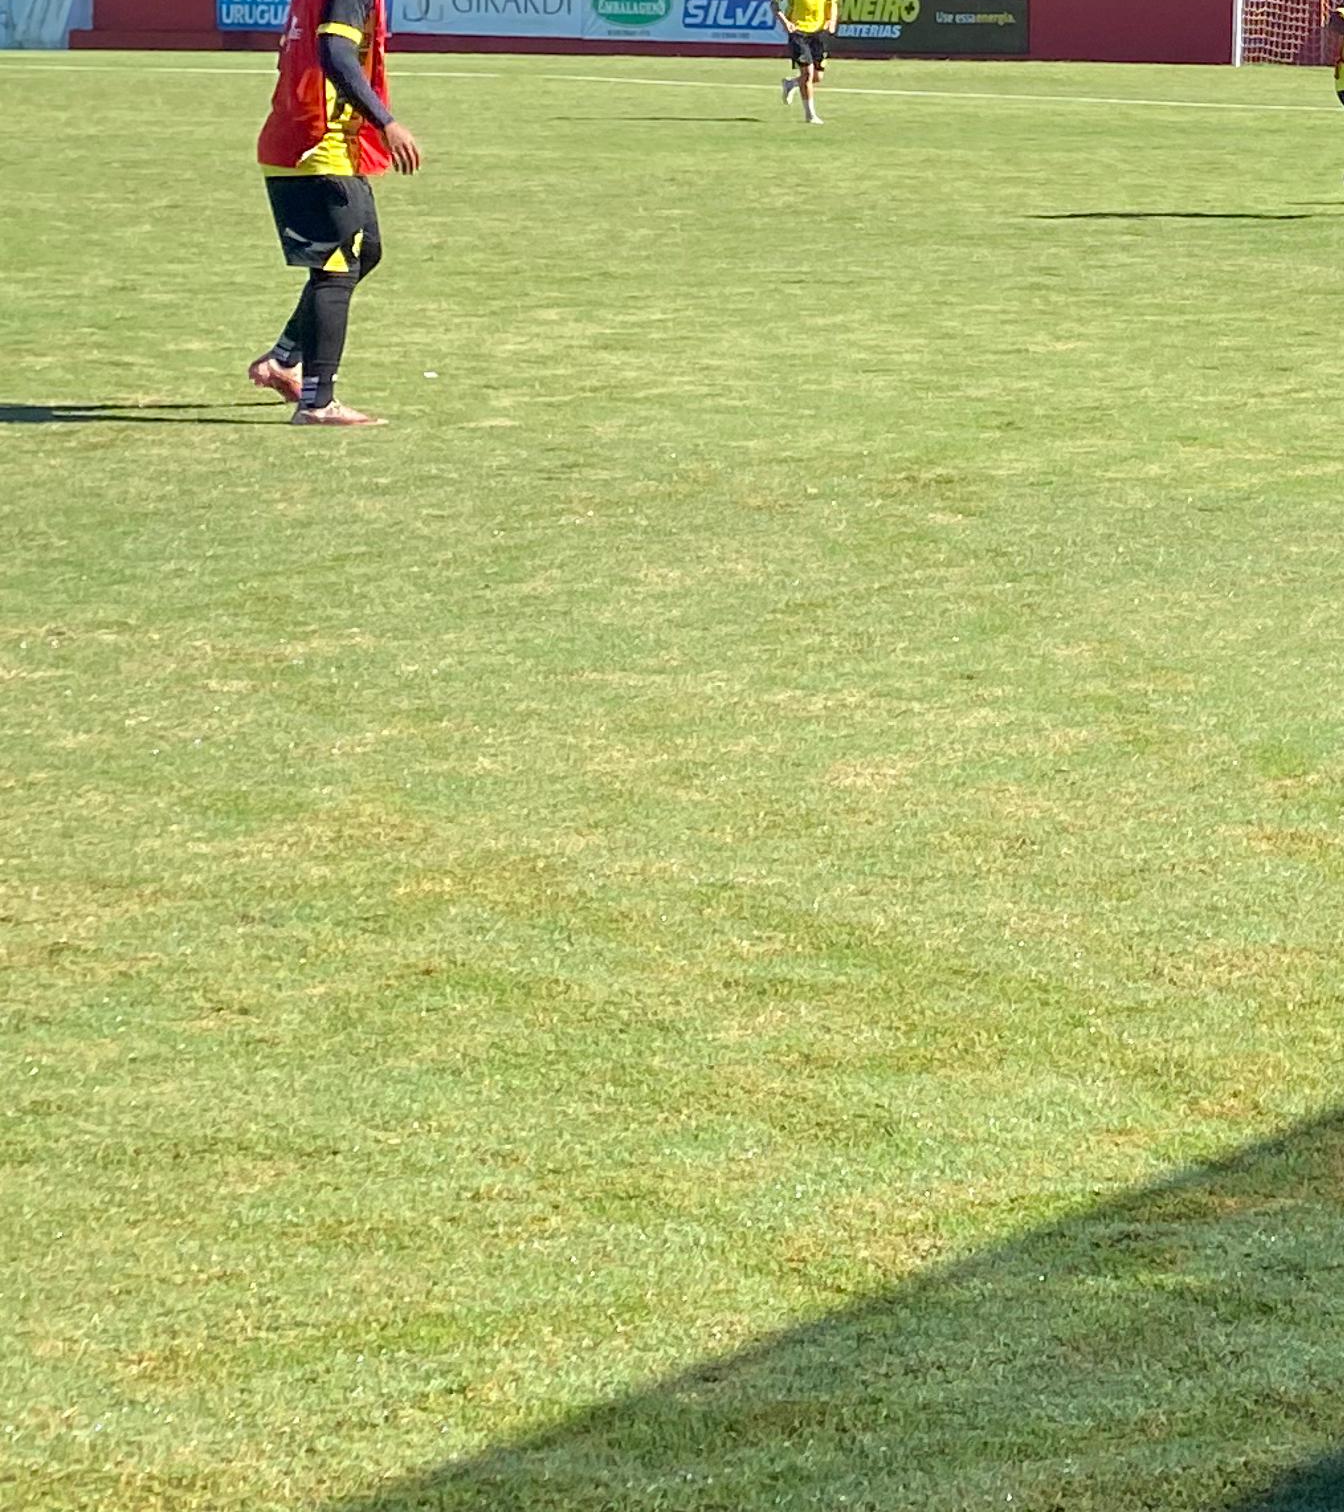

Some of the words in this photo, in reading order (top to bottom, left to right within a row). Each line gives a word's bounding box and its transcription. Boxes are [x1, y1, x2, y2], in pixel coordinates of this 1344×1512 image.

[684, 0, 774, 27] SILVA
[935, 11, 954, 24] Use
[838, 24, 902, 38] BATERIAS
